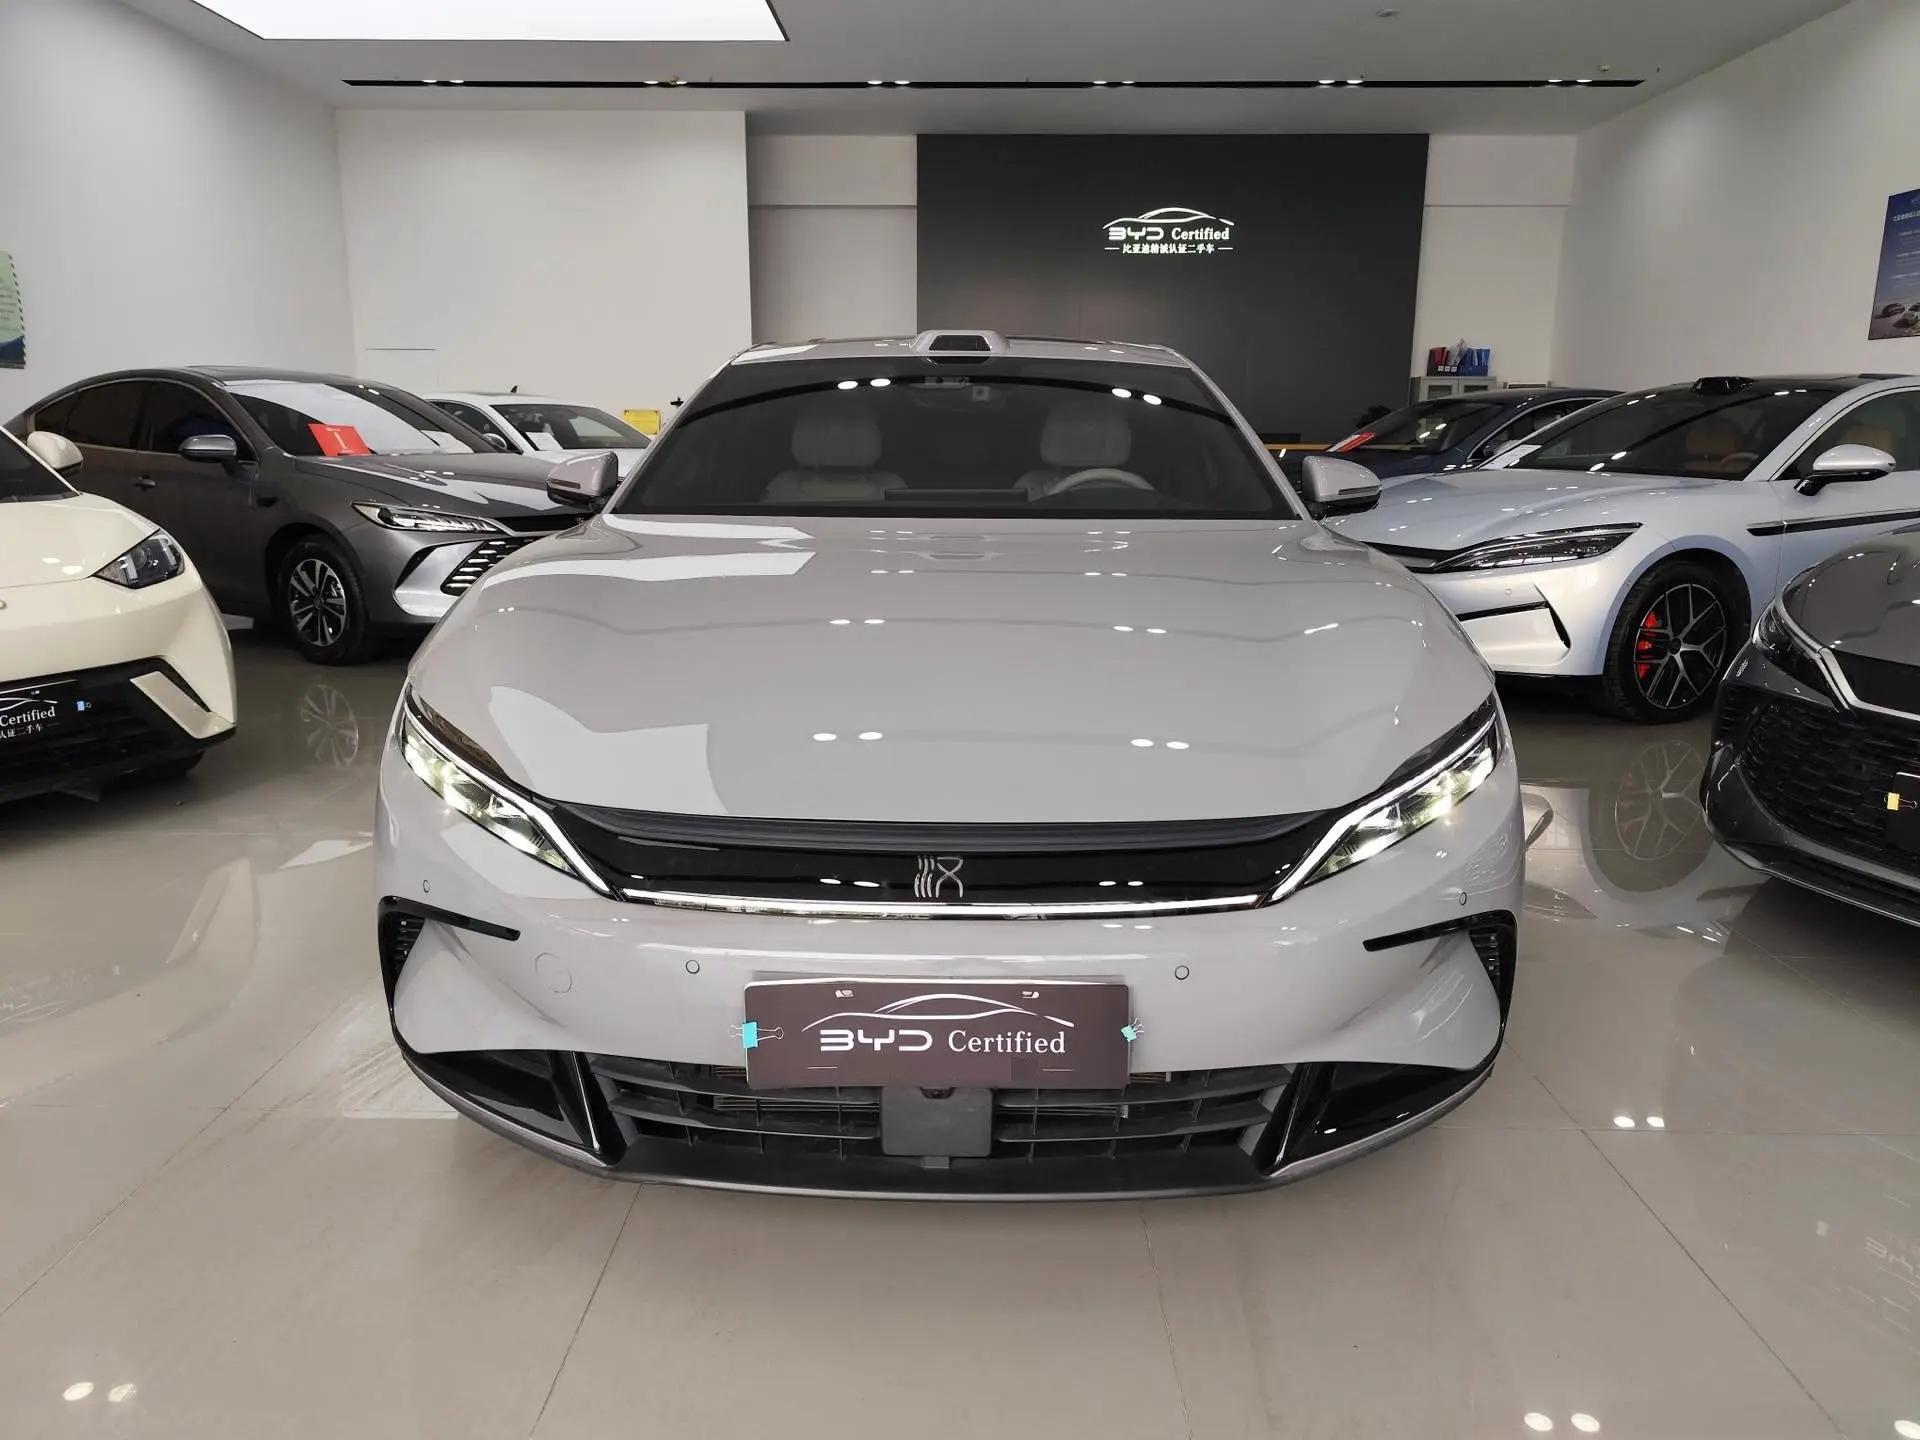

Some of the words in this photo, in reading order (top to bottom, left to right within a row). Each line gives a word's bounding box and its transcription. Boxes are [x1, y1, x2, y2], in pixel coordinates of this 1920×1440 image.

[1108, 226, 1164, 240] BYD
[1171, 227, 1230, 240] Certified
[0, 706, 56, 727] Certified
[820, 1029, 933, 1052] BYD
[948, 1030, 1066, 1054] Certified
